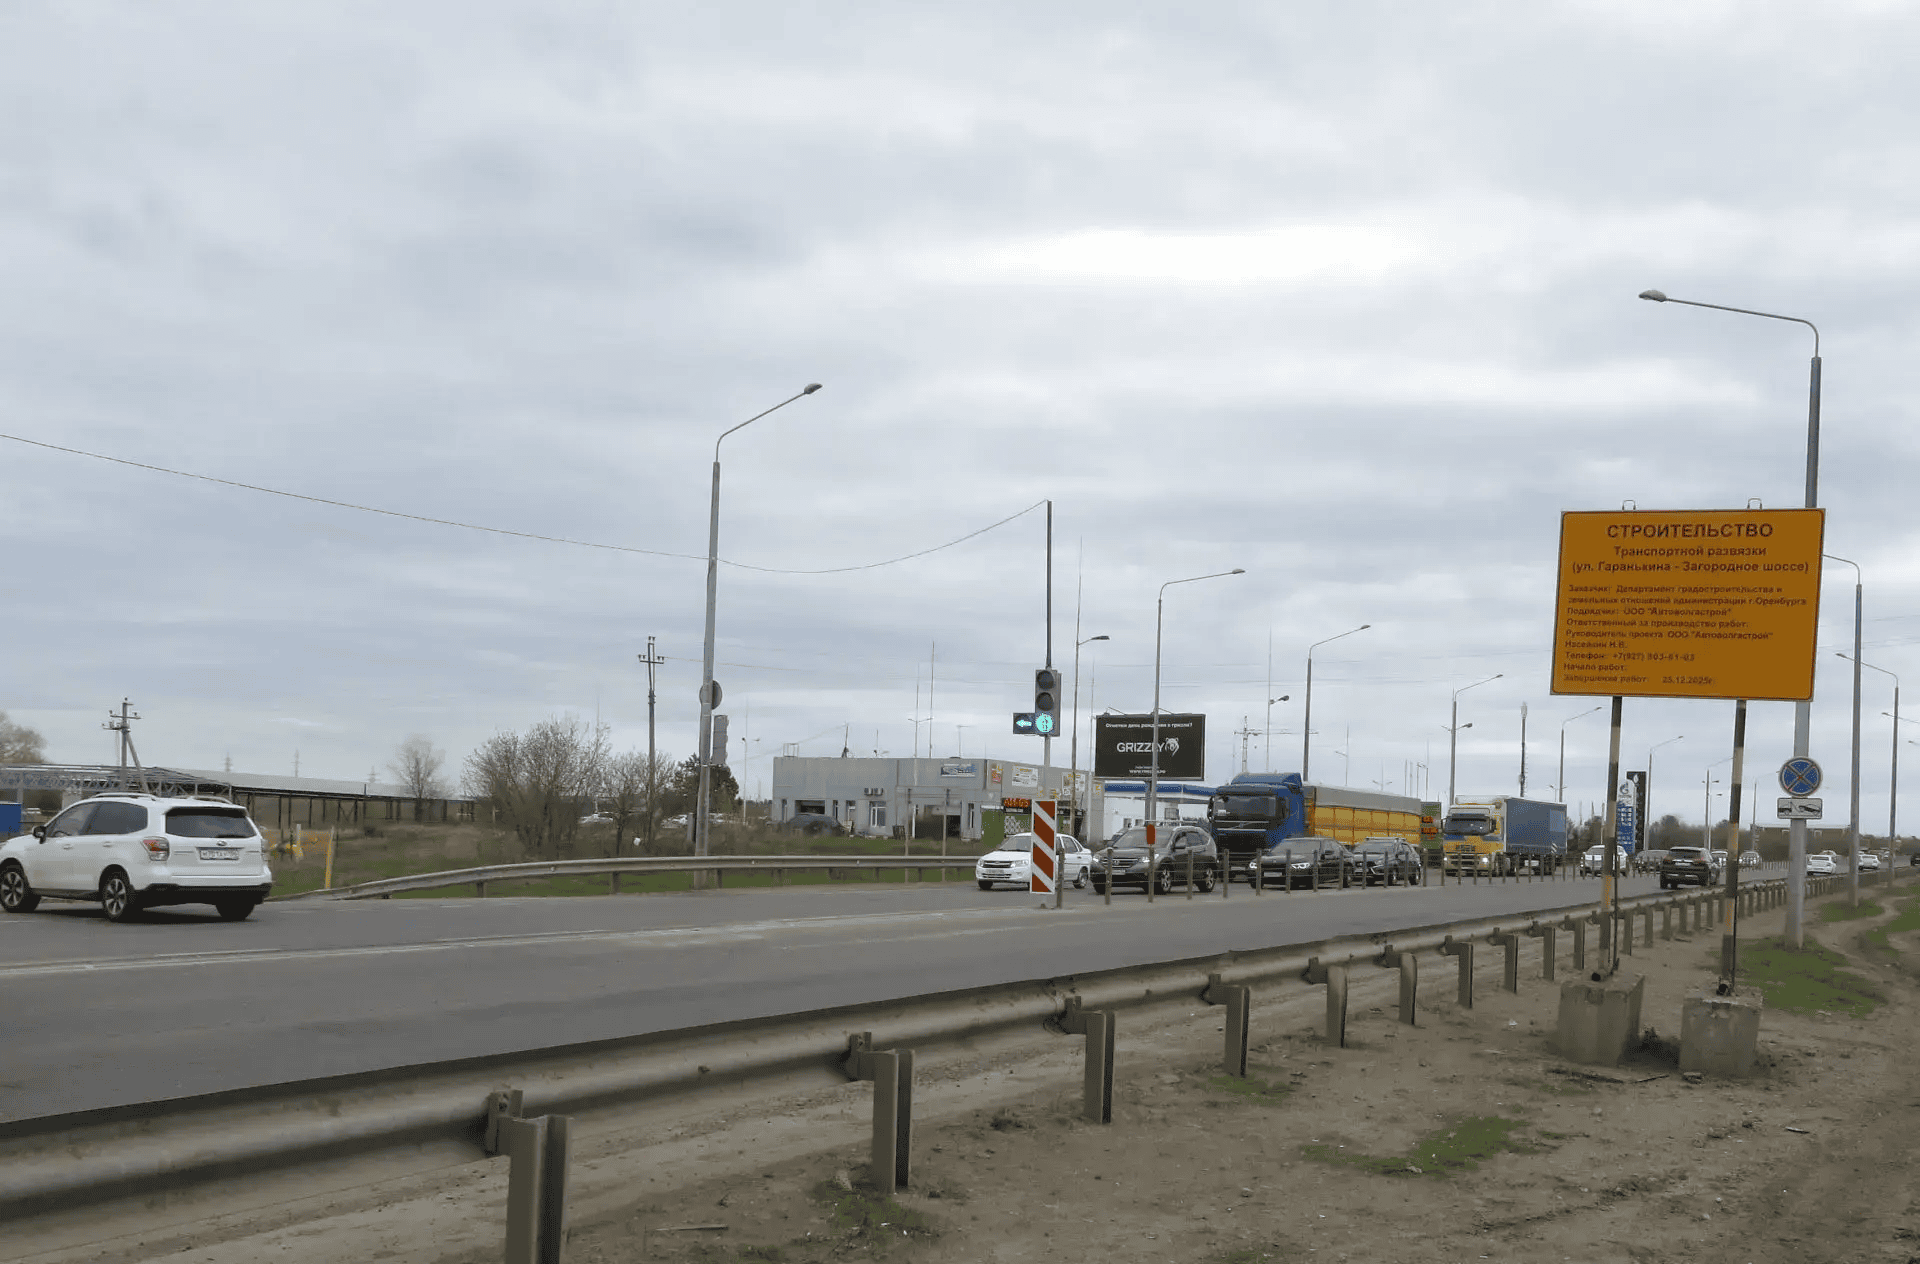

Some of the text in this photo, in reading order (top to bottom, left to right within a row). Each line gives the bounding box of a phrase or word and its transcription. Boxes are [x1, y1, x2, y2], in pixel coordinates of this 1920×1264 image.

[1607, 523, 1774, 538] СТРОИТЕЛЬСТВО
[1614, 546, 1767, 558] Транспортной развязки
[1572, 562, 1594, 574] (ул.
[1598, 562, 1671, 572] Гаранькина
[1683, 562, 1759, 573] Загородное
[1763, 562, 1809, 574] шоссе)
[1616, 585, 1675, 594] Департамент
[1678, 586, 1774, 594] градостроительства
[1620, 597, 1672, 605] отношений
[1624, 608, 1645, 616] ООО
[1653, 620, 1717, 629] производство
[1629, 631, 1664, 640] проекта
[1668, 631, 1688, 639] ООО
